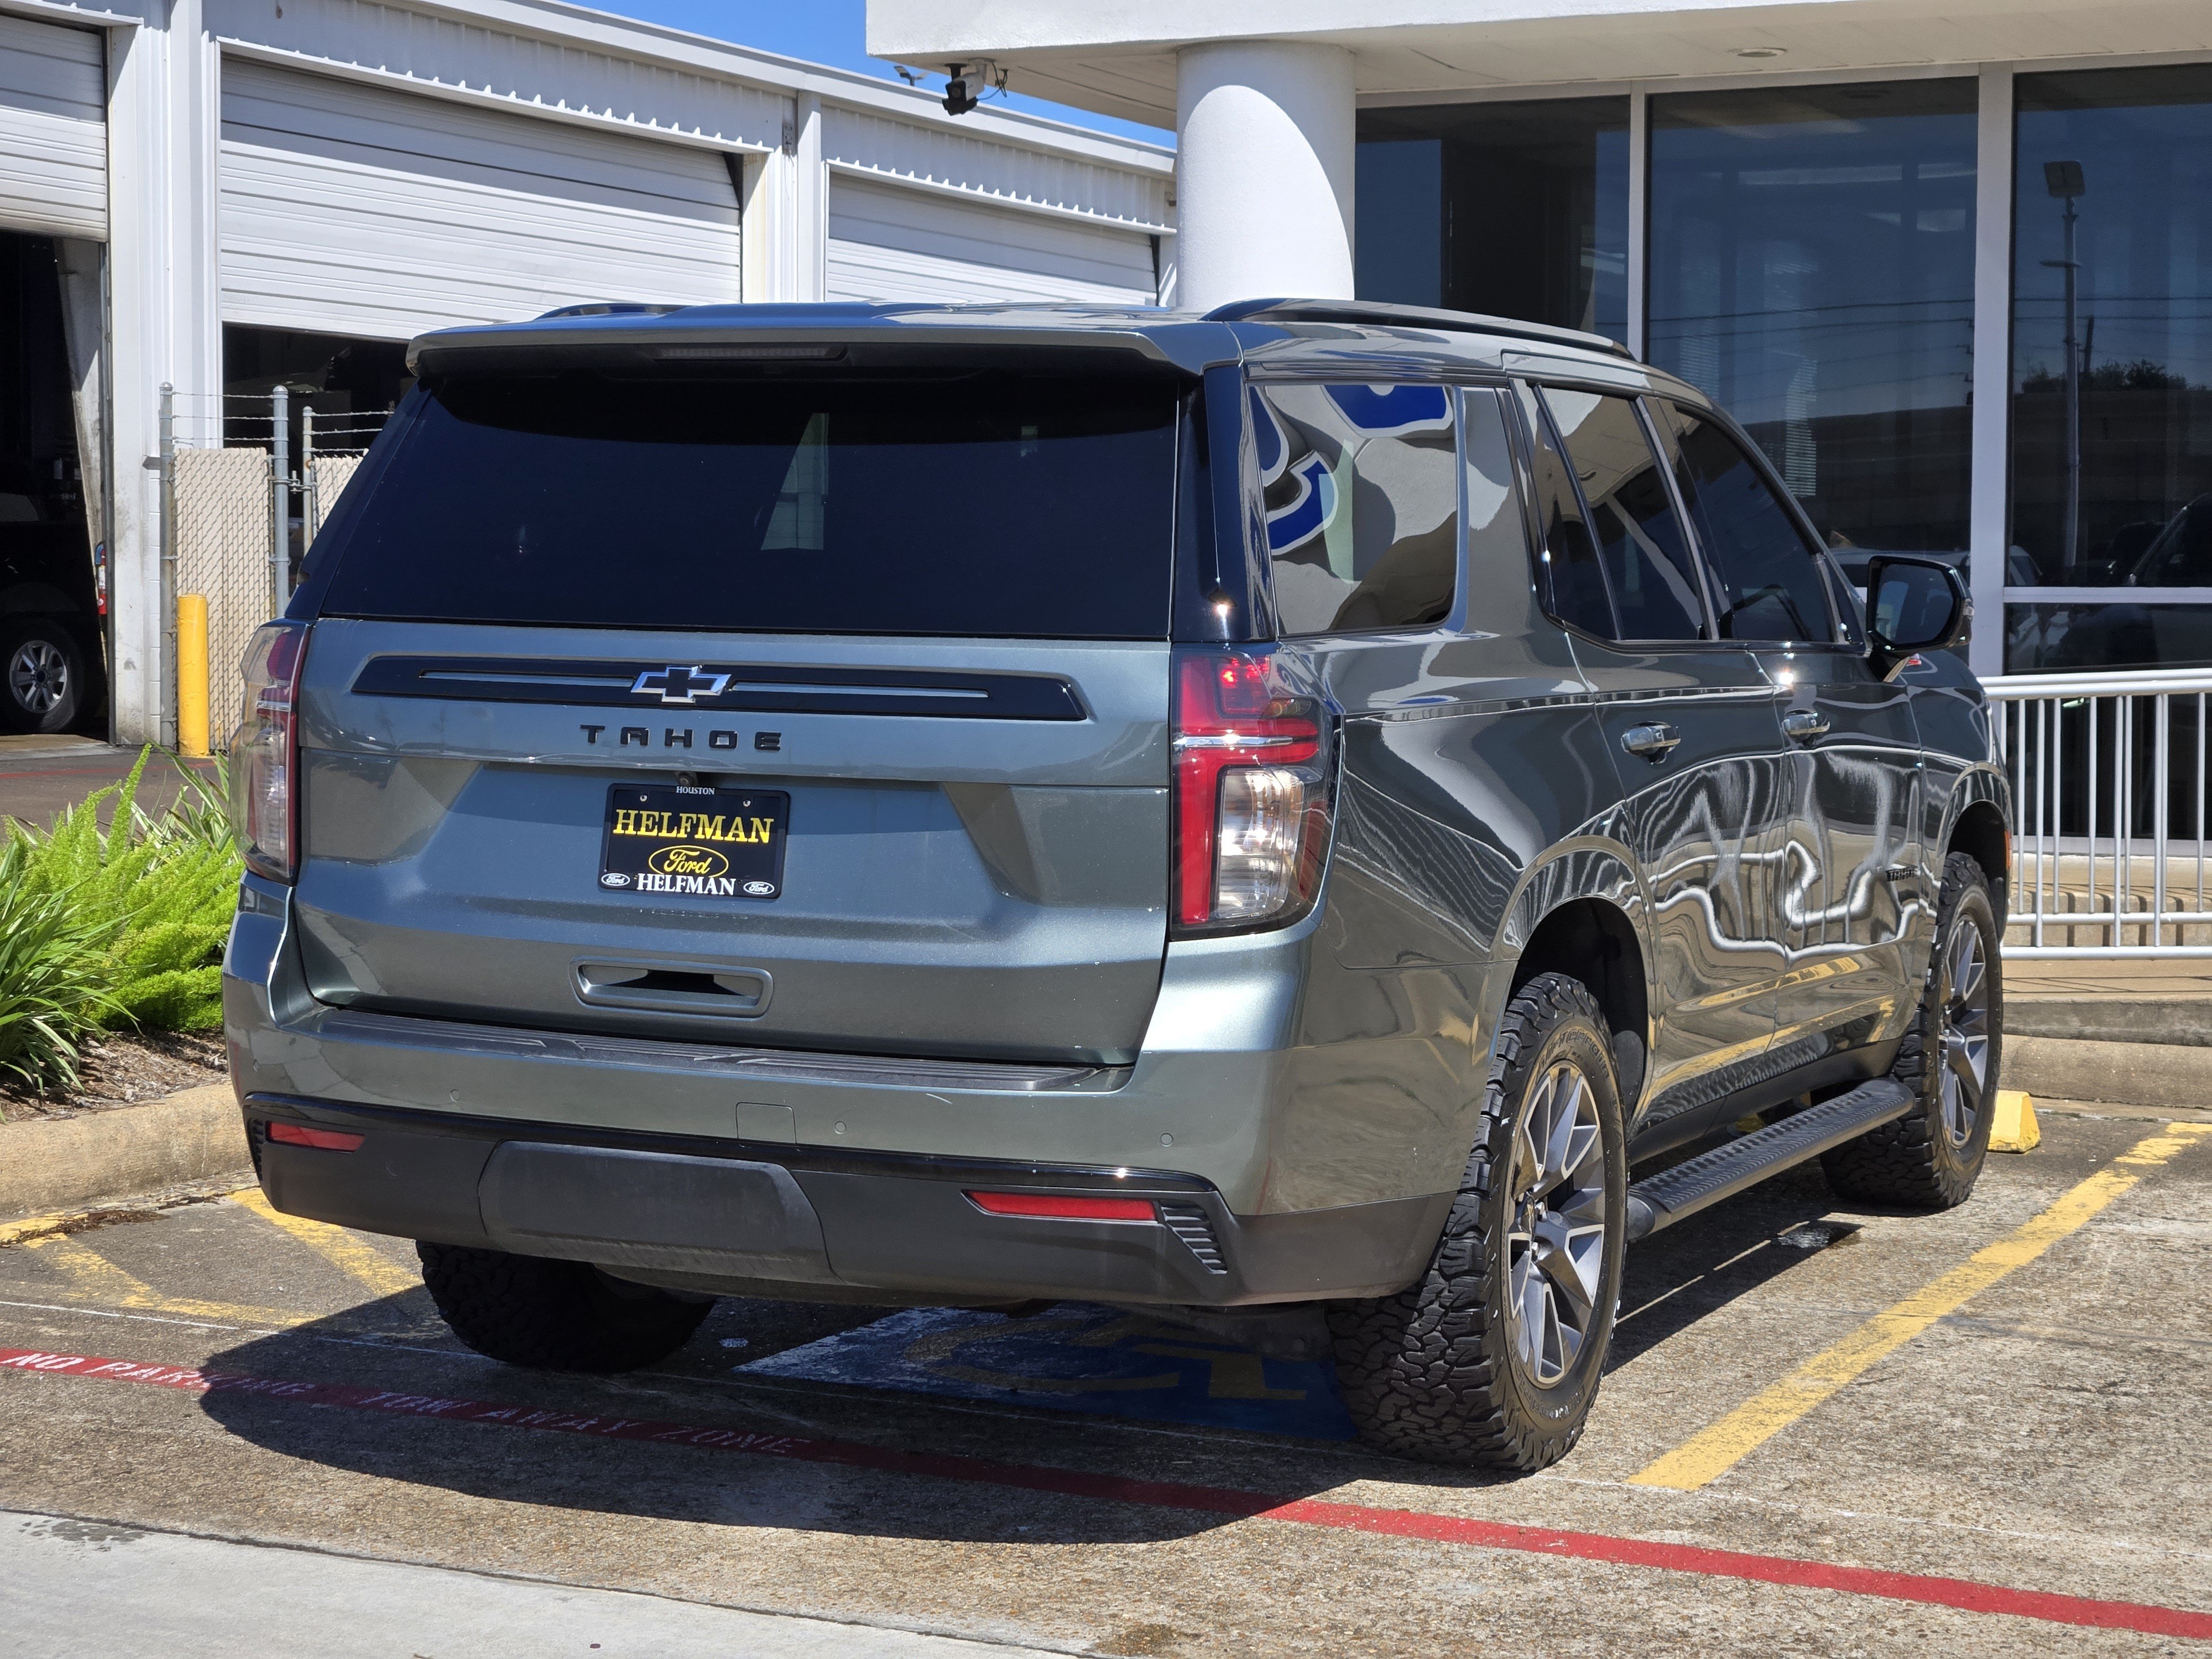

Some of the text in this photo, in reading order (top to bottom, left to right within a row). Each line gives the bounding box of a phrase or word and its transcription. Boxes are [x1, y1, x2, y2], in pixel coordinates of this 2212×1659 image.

[580, 724, 781, 751] TAHOE
[676, 786, 715, 795] HOUSTON
[613, 808, 774, 843] HELFMAN
[663, 849, 713, 874] Ford
[636, 873, 737, 896] HELFMAN
[0, 1353, 812, 1453] NO PARKING TOW AWAY ZONE
